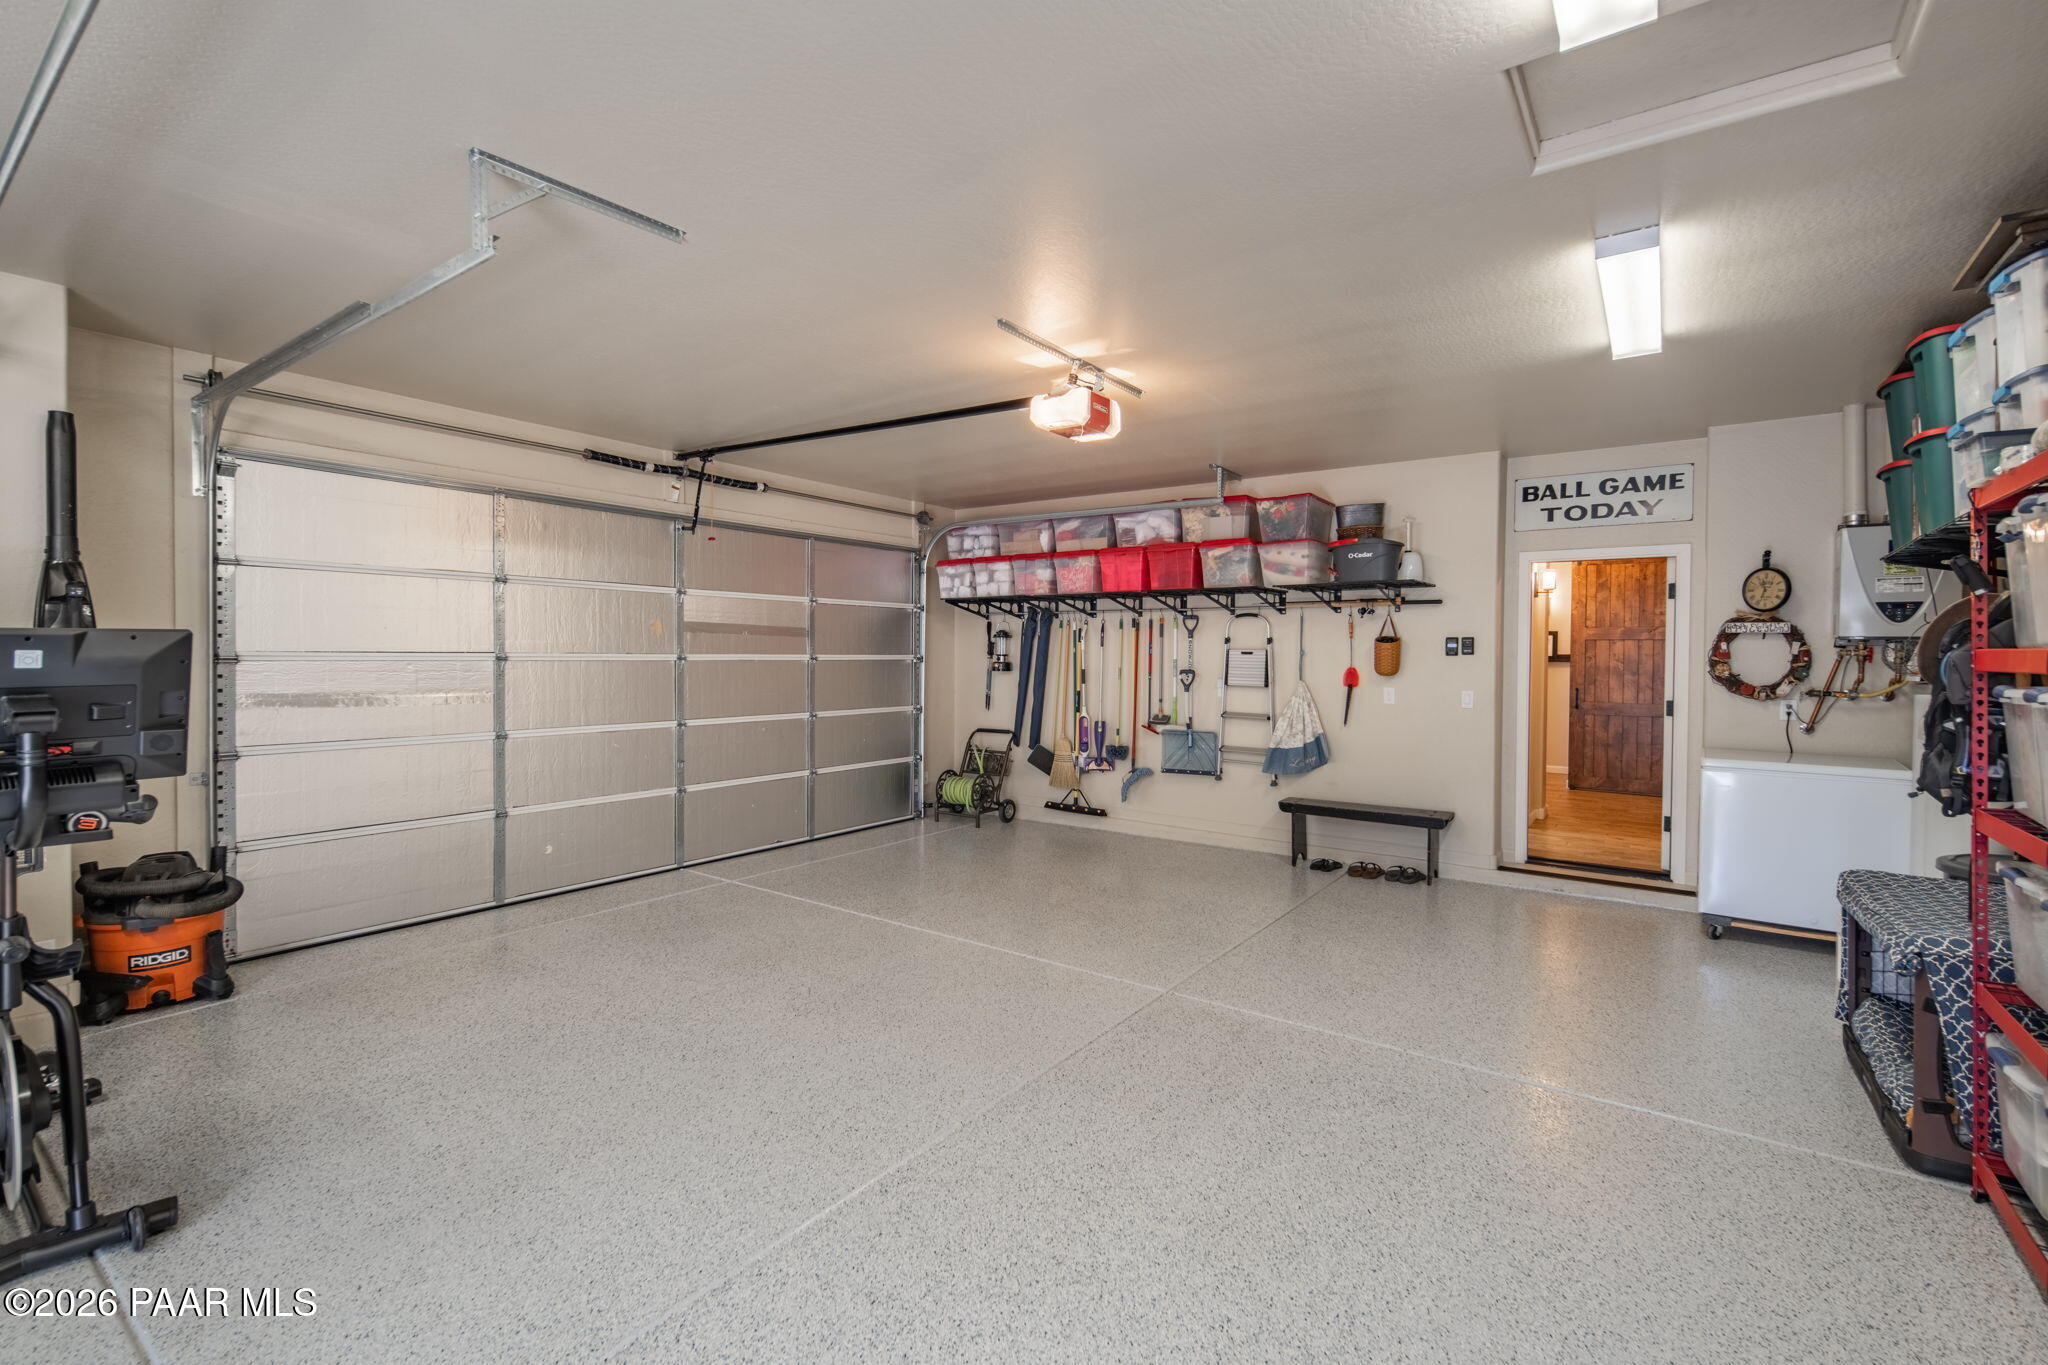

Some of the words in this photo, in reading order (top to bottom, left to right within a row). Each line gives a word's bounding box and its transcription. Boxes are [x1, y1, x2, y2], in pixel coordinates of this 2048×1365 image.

[1522, 481, 1591, 502] BALL
[1598, 472, 1685, 496] GAME
[1540, 498, 1664, 522] TODAY
[1347, 551, 1374, 559] O-Cedar
[130, 948, 189, 968] RIDGID
